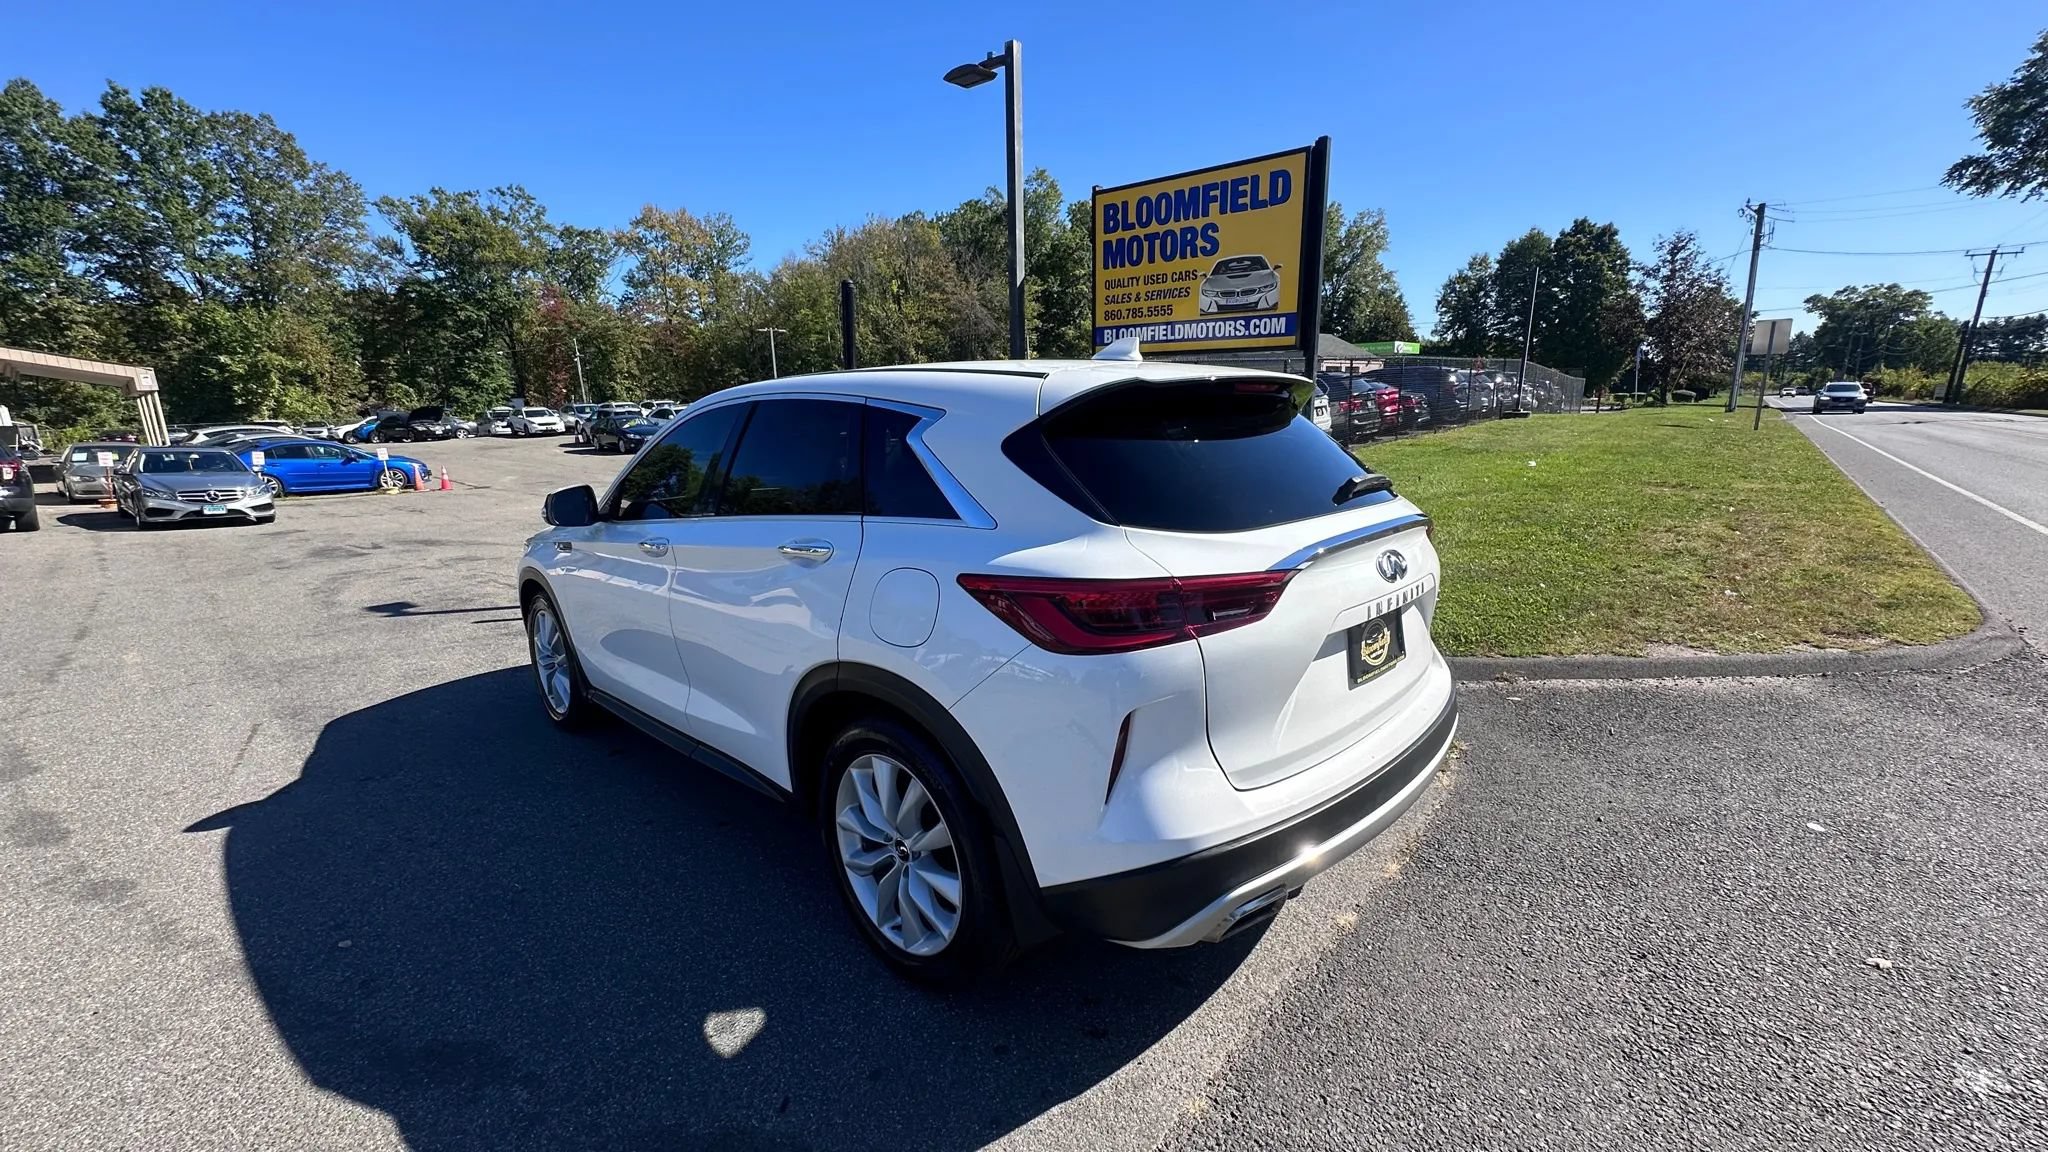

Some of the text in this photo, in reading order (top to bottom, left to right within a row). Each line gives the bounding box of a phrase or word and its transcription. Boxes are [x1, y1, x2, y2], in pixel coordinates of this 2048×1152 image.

[1103, 170, 1292, 235] BLOOMFIELD
[1102, 222, 1220, 270] MOTORS
[1104, 269, 1198, 291] QUALITY USED CARS
[1104, 286, 1191, 306] SALES & SERVICES
[1104, 304, 1174, 321] 860.785.5555
[1103, 317, 1287, 344] BLOOMFIELDMOTORS.COM
[1367, 581, 1424, 620] INFINITI
